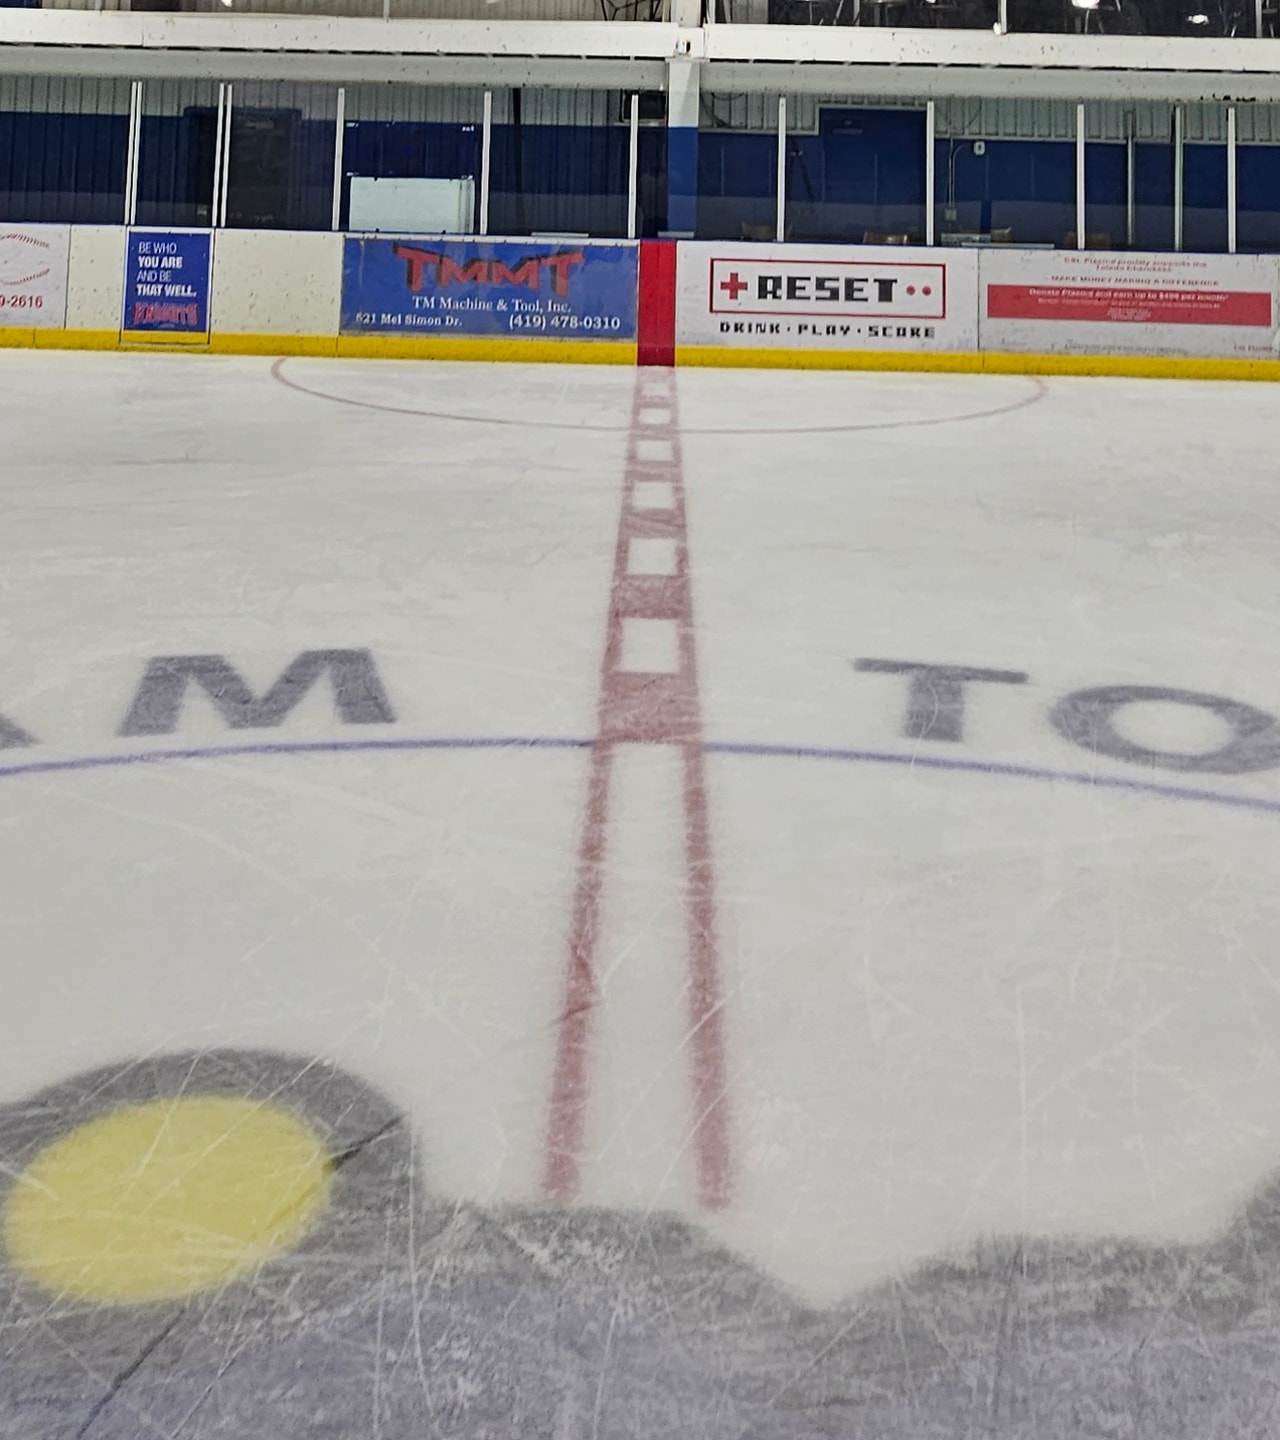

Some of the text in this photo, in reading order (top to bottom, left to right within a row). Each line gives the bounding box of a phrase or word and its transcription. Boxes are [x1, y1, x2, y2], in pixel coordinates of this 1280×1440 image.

[138, 241, 177, 255] BE WHO
[138, 255, 183, 269] YOU ARE
[392, 242, 586, 297] TMMT
[137, 269, 172, 282] AND BE
[137, 283, 197, 297] THAT WELL.
[758, 275, 898, 302] RESET
[412, 295, 572, 314] TM Machine & Tool, Inc.
[380, 312, 402, 325] Mel
[404, 314, 441, 327] Simon
[445, 315, 463, 327] Dr.
[508, 314, 546, 331] (419)
[550, 314, 621, 330] 478-0310
